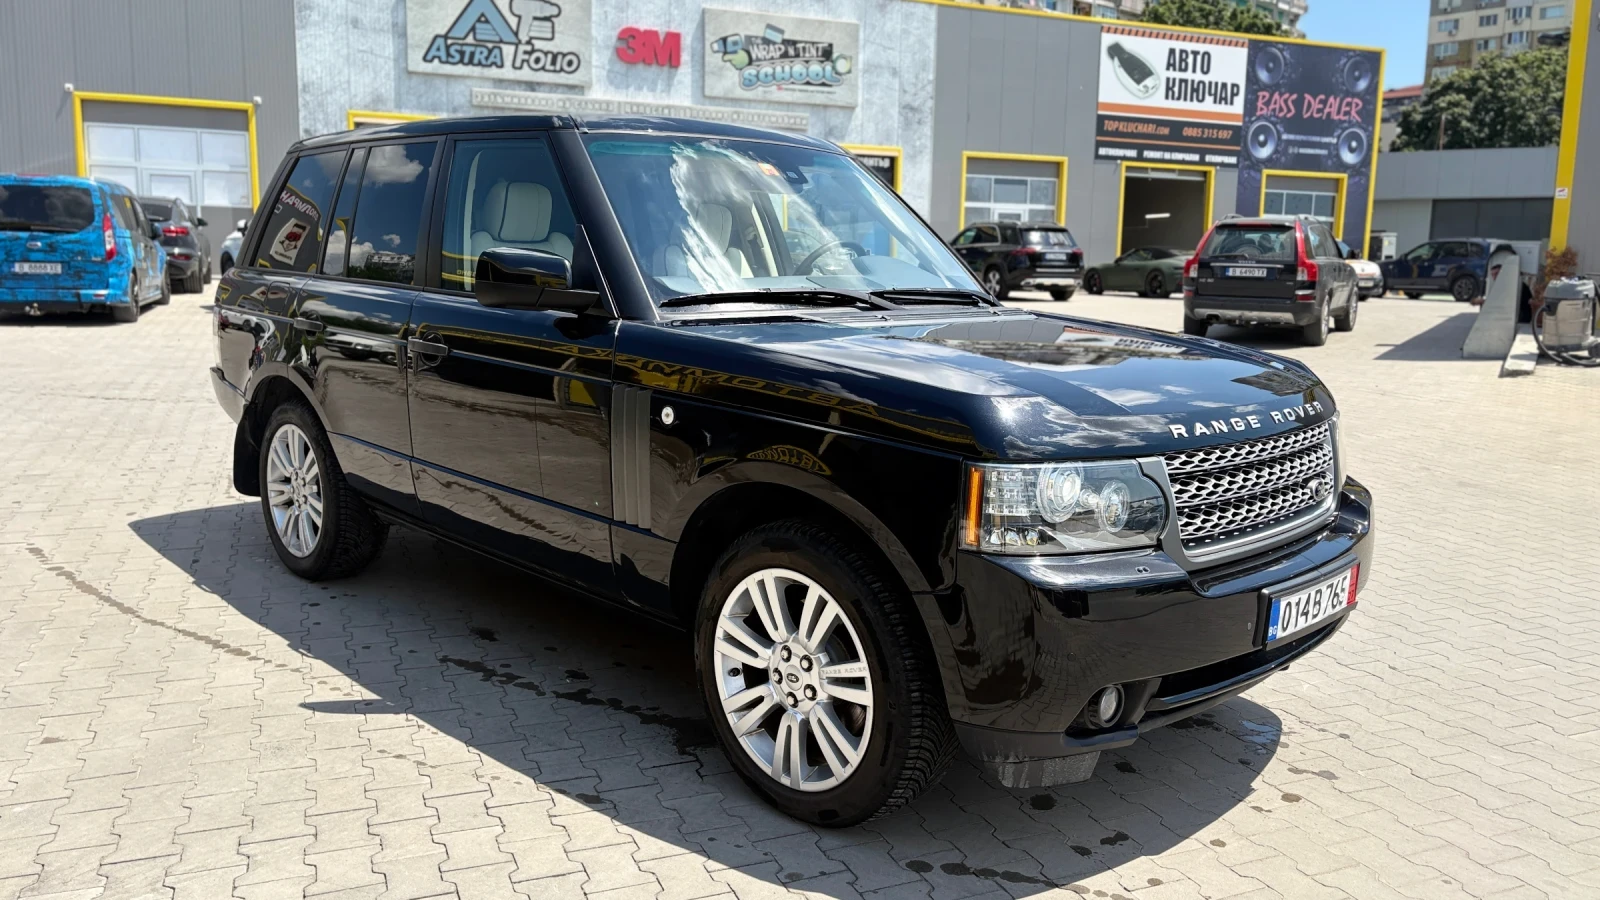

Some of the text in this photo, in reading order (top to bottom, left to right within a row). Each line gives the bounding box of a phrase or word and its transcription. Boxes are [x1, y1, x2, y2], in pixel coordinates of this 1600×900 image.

[423, 35, 581, 74] ASTRA FOLIO
[616, 27, 682, 69] 3M
[749, 43, 786, 61] WRAP
[796, 42, 829, 57] TINT
[1165, 47, 1212, 75] АВТО
[741, 61, 842, 89] SCHOOL
[1164, 76, 1240, 106] КЛЮЧАР
[1256, 91, 1363, 122] BASS DEALER
[1239, 268, 1256, 276] 6490
[1168, 401, 1324, 438] RANGE ROVER
[1268, 625, 1278, 637] BG
